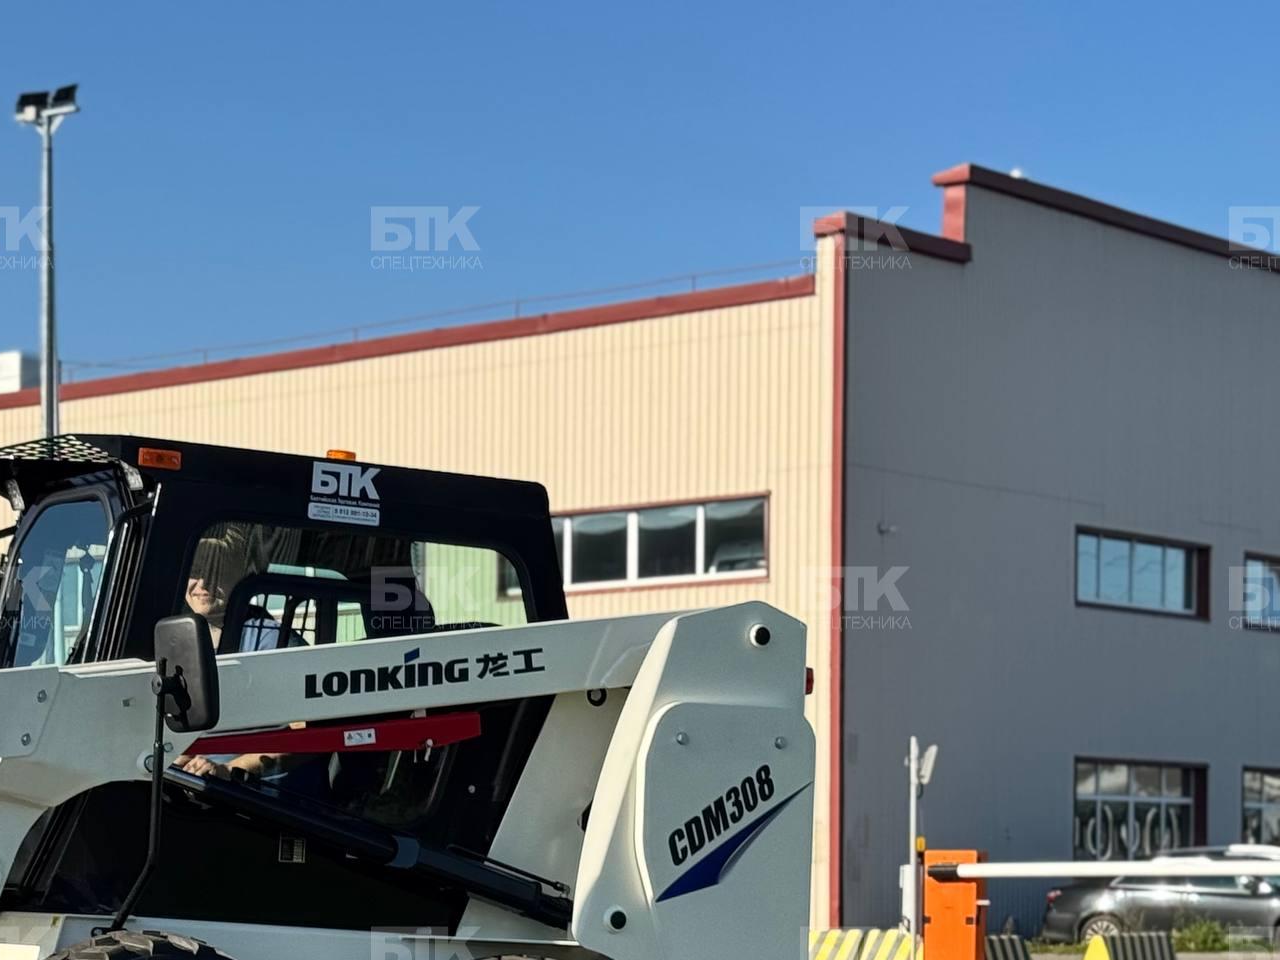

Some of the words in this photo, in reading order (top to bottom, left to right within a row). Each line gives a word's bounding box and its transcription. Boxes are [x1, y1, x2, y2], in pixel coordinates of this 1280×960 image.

[311, 461, 381, 500] БТК
[475, 648, 546, 680] 龙工
[668, 764, 775, 866] CDM308
